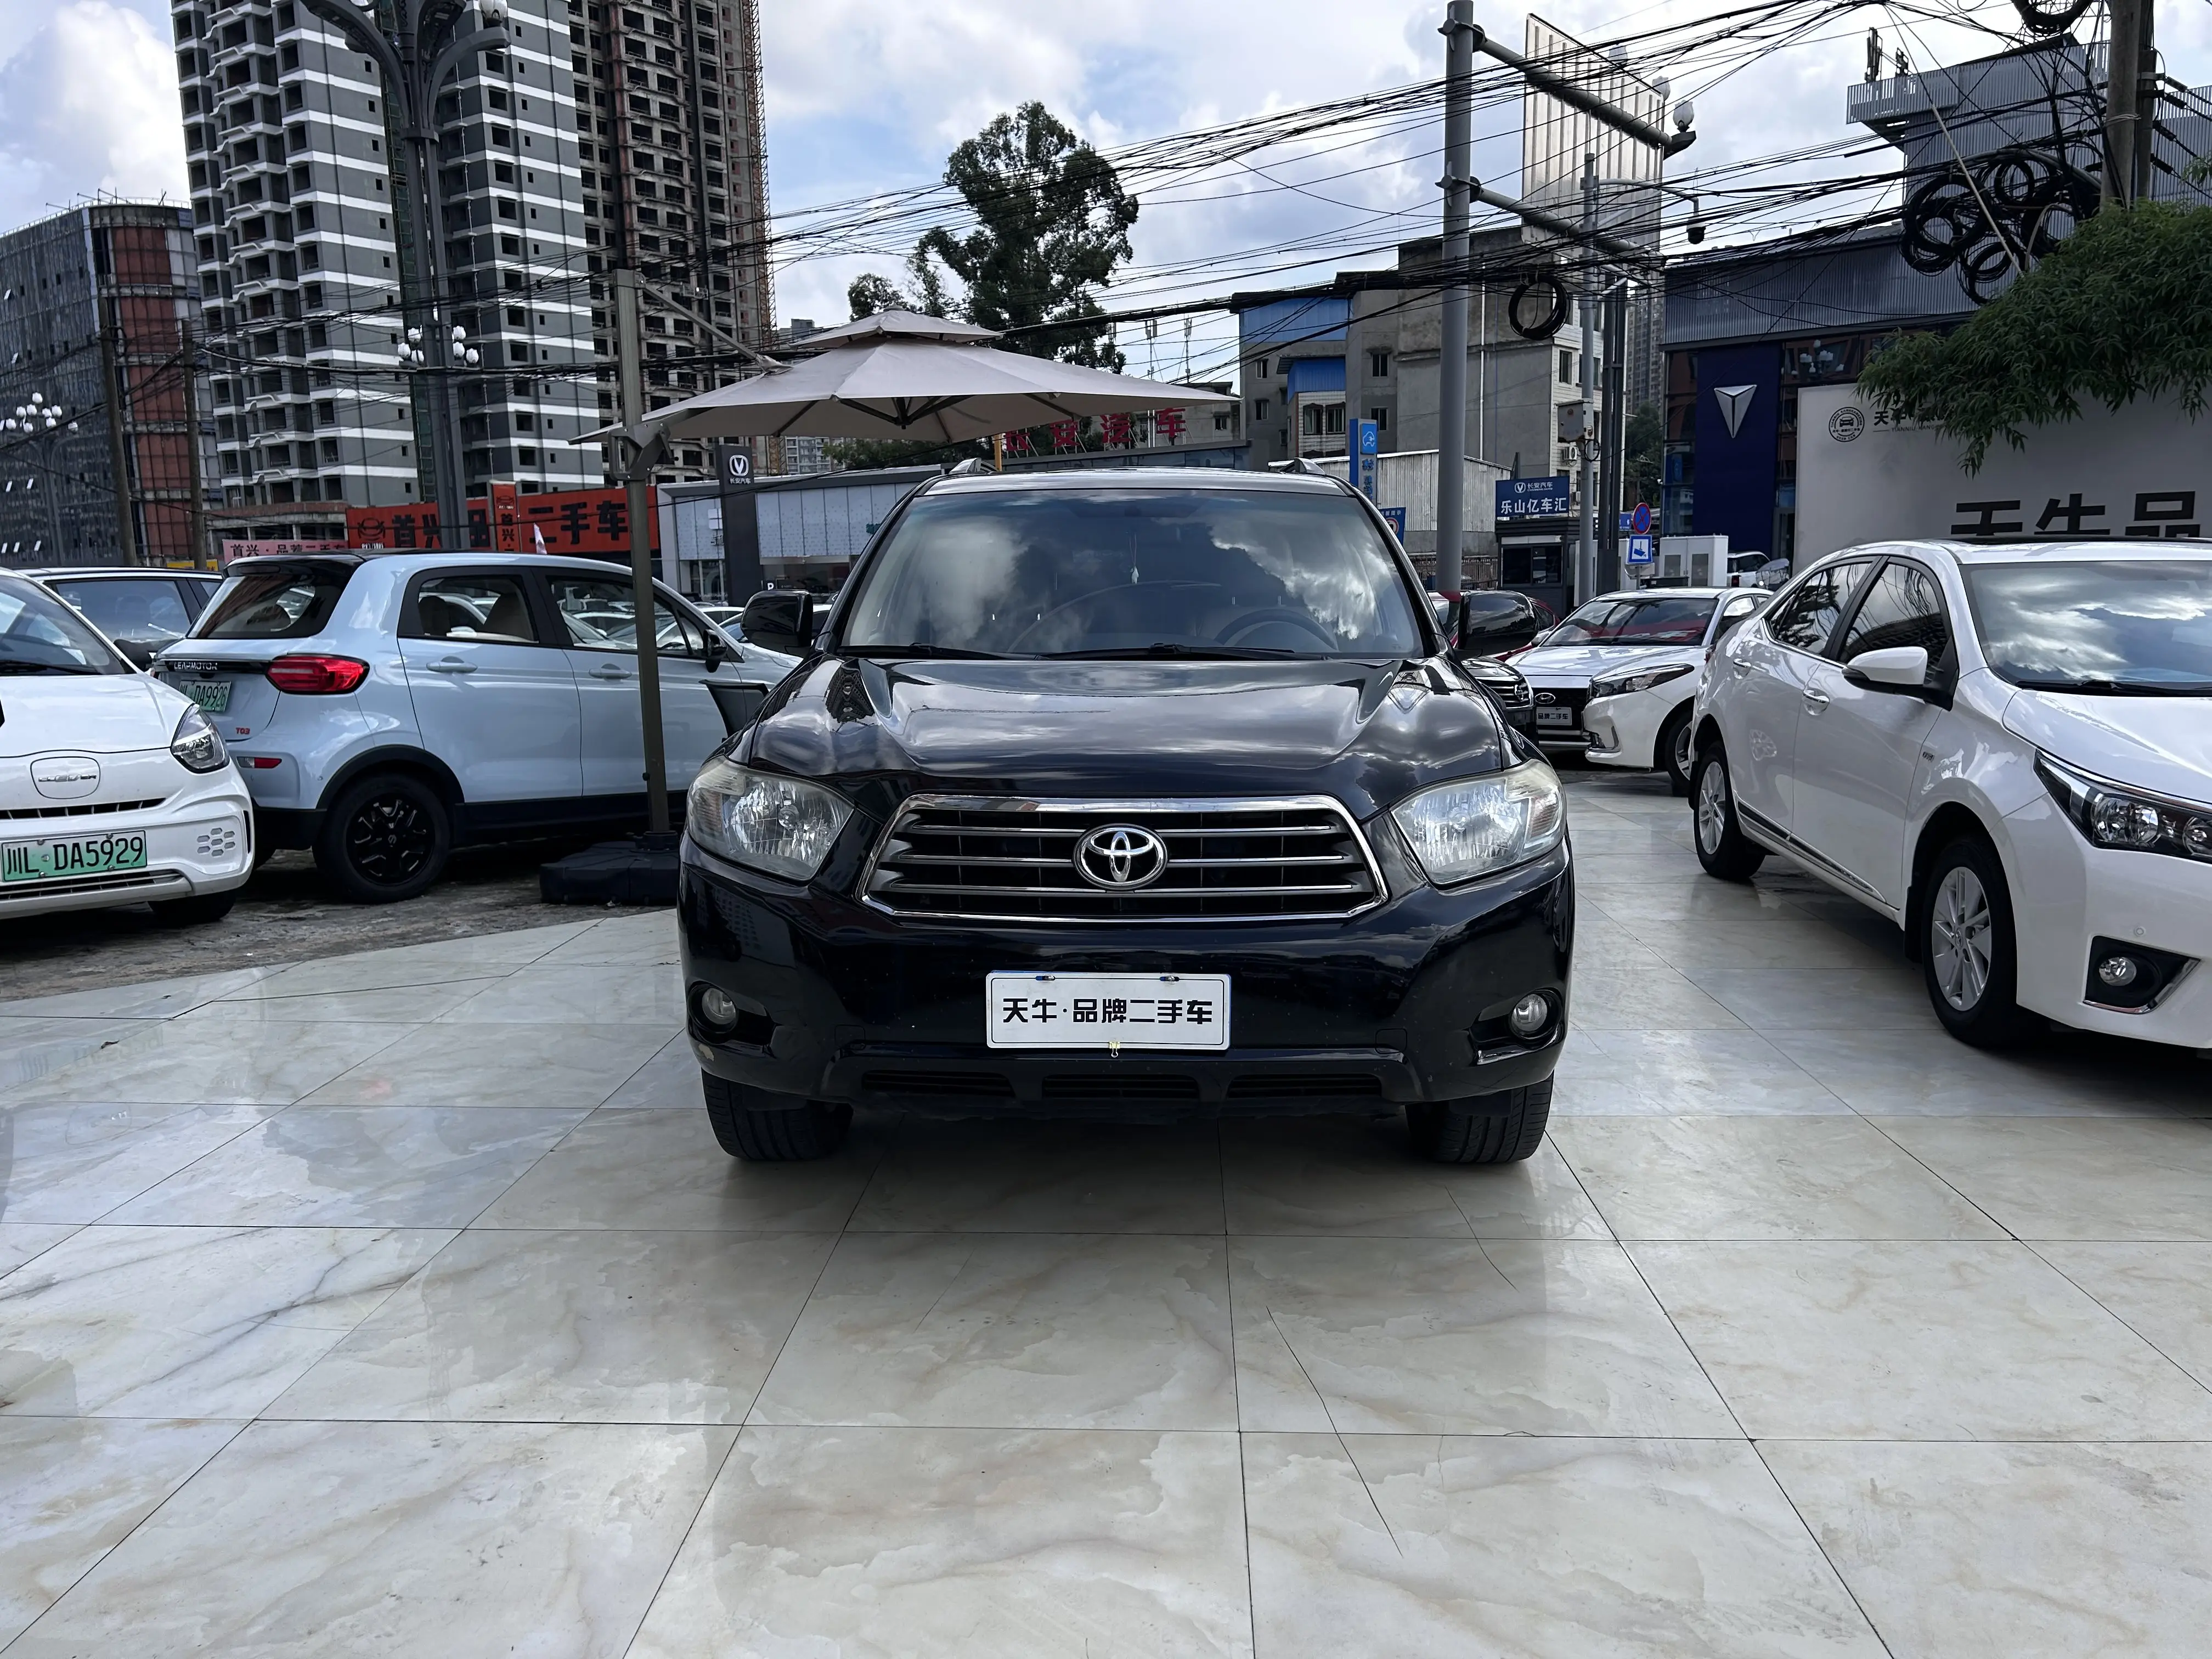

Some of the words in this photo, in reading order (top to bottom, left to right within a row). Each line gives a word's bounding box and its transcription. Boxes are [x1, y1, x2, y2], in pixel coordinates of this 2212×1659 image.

[1500, 497, 1567, 515] 乐山亿车汇
[501, 513, 515, 552] 首兴·
[53, 837, 143, 871] DA5929
[1003, 998, 1212, 1025] 天牛·品牌二手车
